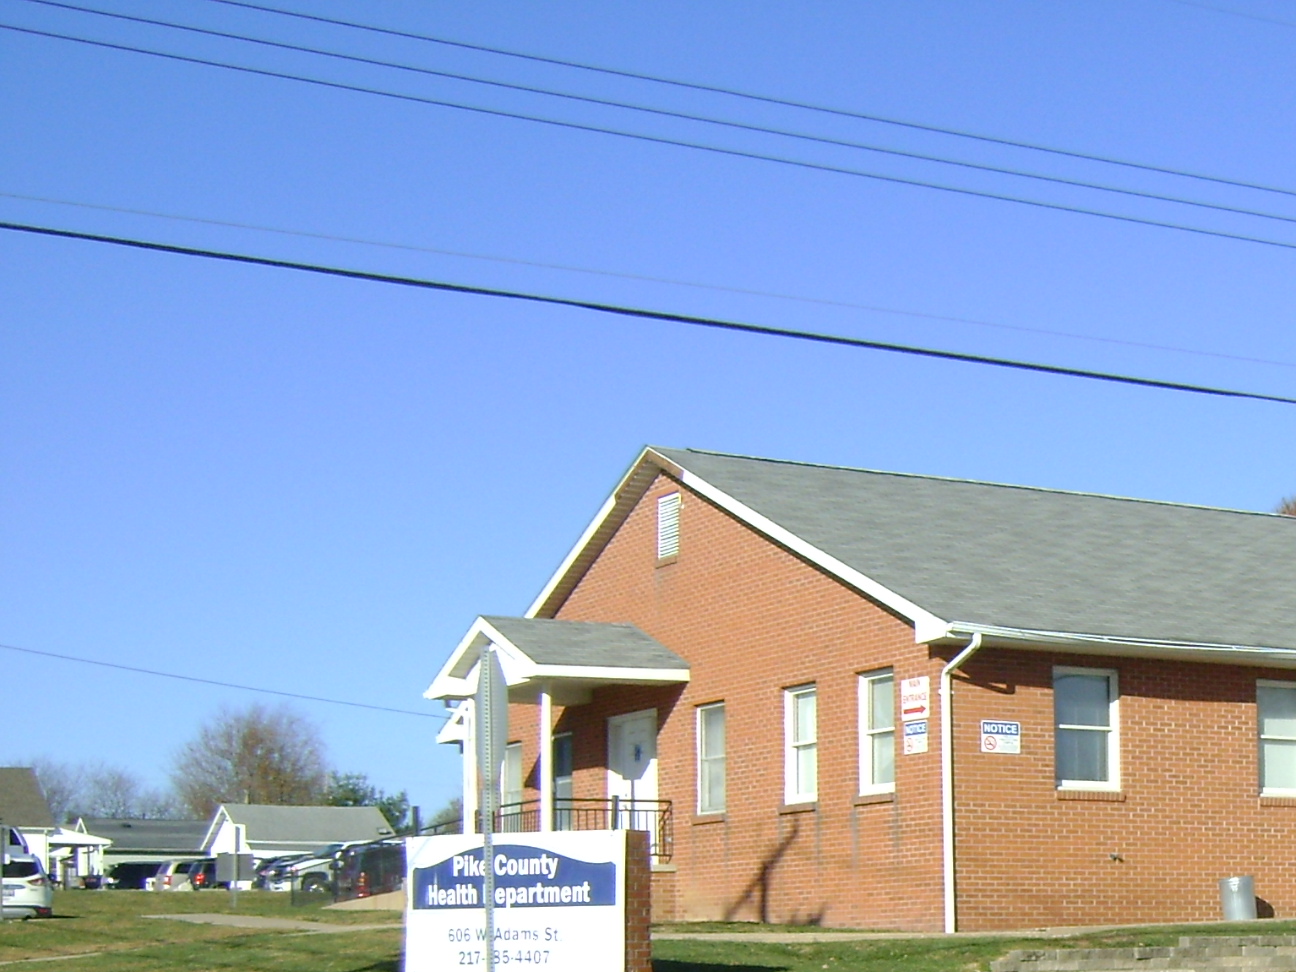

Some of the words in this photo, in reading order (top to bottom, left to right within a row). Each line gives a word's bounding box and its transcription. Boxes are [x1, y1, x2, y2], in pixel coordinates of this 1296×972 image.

[903, 692, 927, 704] ENTRANCE
[905, 724, 927, 735] NOTICE
[984, 724, 1018, 735] NOTICE
[453, 855, 486, 877] Pike
[494, 854, 559, 879] County
[428, 884, 477, 905] Health
[448, 928, 471, 942] 606
[494, 927, 539, 941] Adams
[544, 927, 563, 941] St.
[459, 950, 550, 965] 217-85-4407
